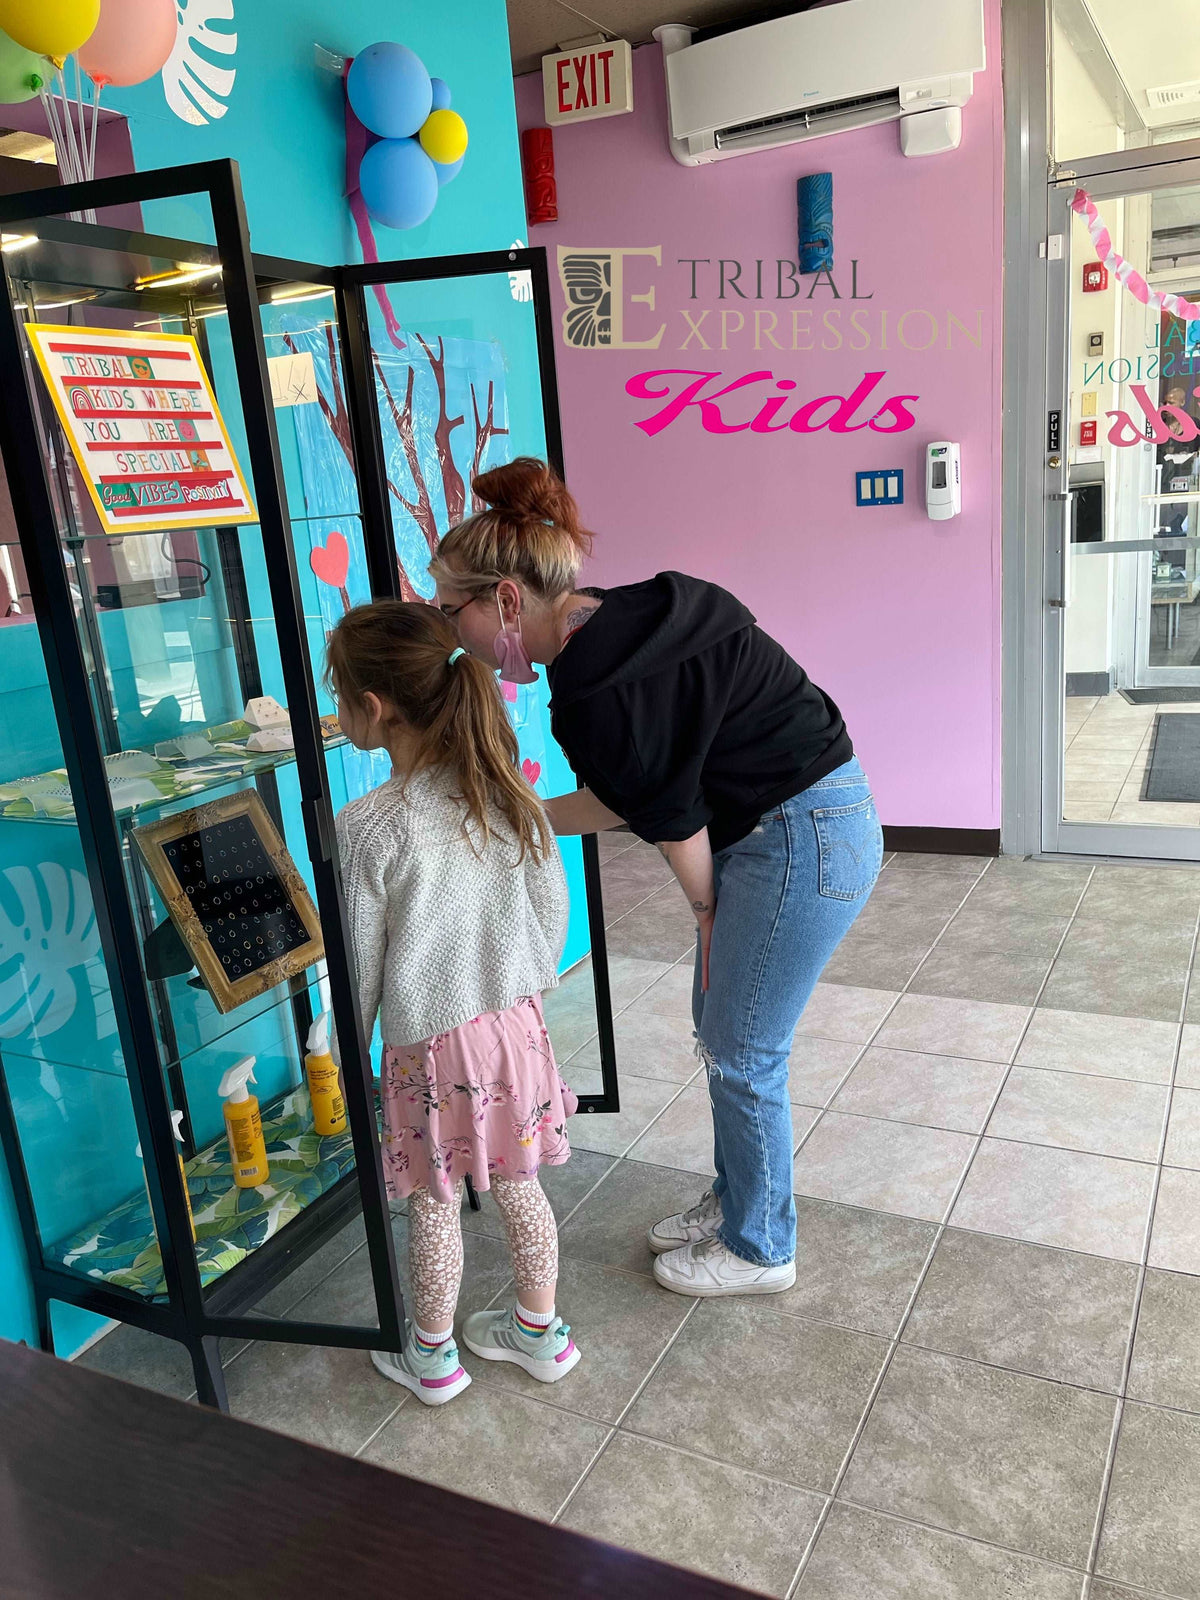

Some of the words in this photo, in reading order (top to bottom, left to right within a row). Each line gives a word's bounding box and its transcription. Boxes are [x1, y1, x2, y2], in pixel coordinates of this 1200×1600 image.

[556, 49, 614, 113] EXIT
[677, 259, 874, 300] TRIBAL
[62, 355, 132, 378] TRIBAL
[90, 388, 135, 409] KIDS
[142, 389, 201, 412] WHERE
[625, 369, 920, 437] Kids
[84, 421, 121, 441] YOU
[147, 421, 180, 441] ARE
[1050, 413, 1058, 449] PULL
[116, 452, 191, 473] SPECIAL
[102, 485, 132, 505] Good
[132, 480, 180, 506] VIBES
[181, 478, 230, 503] POSITIVITY
